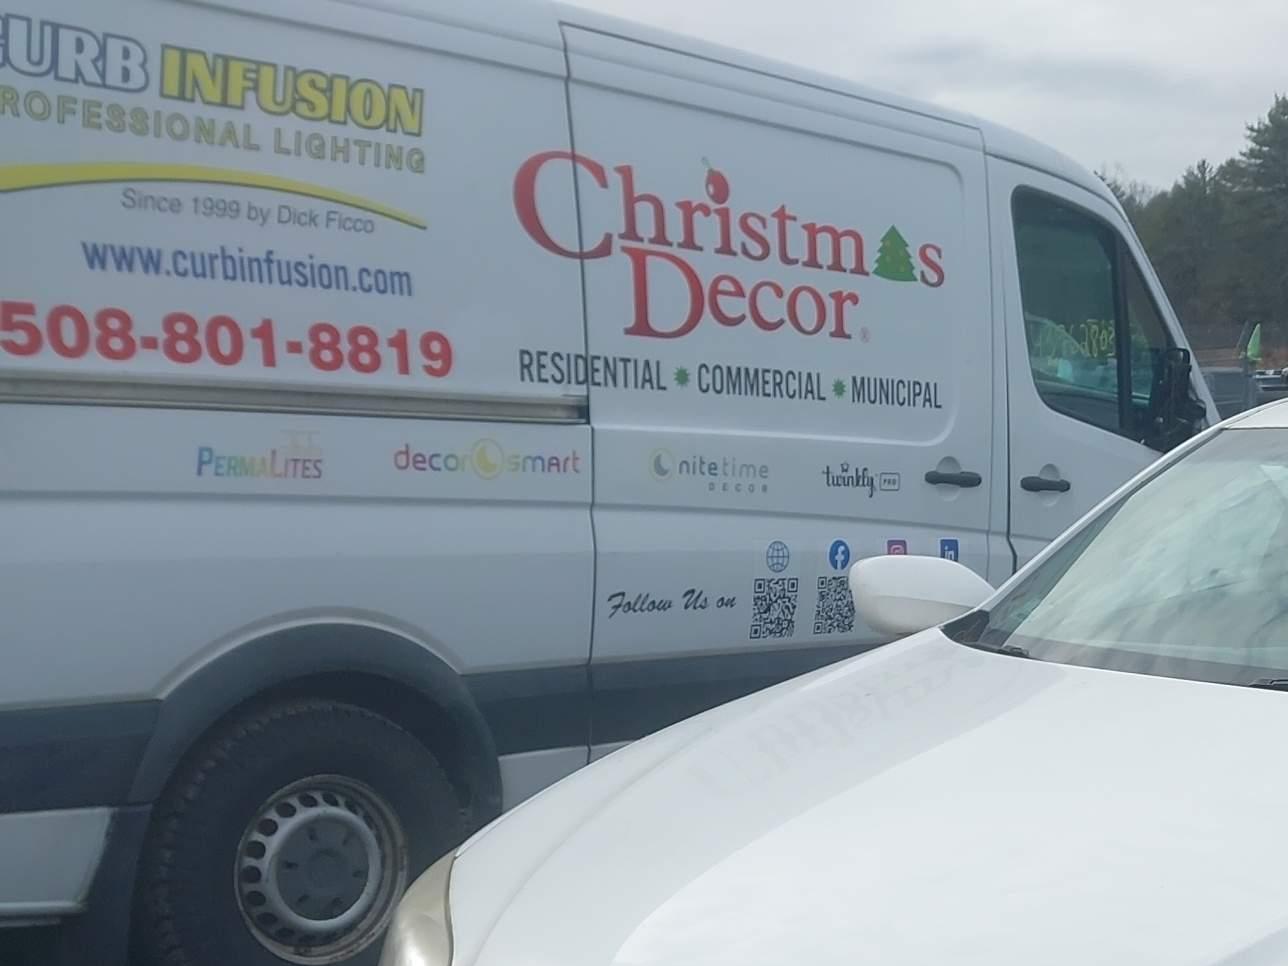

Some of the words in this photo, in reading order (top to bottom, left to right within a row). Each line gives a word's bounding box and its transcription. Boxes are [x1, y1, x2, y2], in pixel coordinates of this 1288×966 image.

[0, 13, 149, 93] URB
[161, 44, 425, 137] INFUSION
[0, 85, 260, 151] ROFESSIONAL
[274, 127, 426, 174] LIGHTING
[121, 188, 183, 214] Since
[191, 196, 240, 220] 1999
[247, 201, 270, 227] by
[277, 205, 318, 229] Dick
[325, 210, 375, 234] Ficco
[511, 148, 945, 288] Christms
[81, 240, 413, 296] www.curbinfusion.com
[619, 245, 860, 339] Decor
[0, 300, 454, 379] 508-801-8819
[518, 348, 667, 391] RESIDENTIAL
[697, 363, 826, 401] COMMERCIAL
[851, 375, 943, 408] MUNICIPAL
[678, 455, 770, 479] nitetime
[708, 481, 769, 493] DECOR
[822, 462, 875, 498] twinkly
[607, 590, 673, 619] Follow
[681, 588, 708, 610] Us
[715, 594, 737, 609] on
